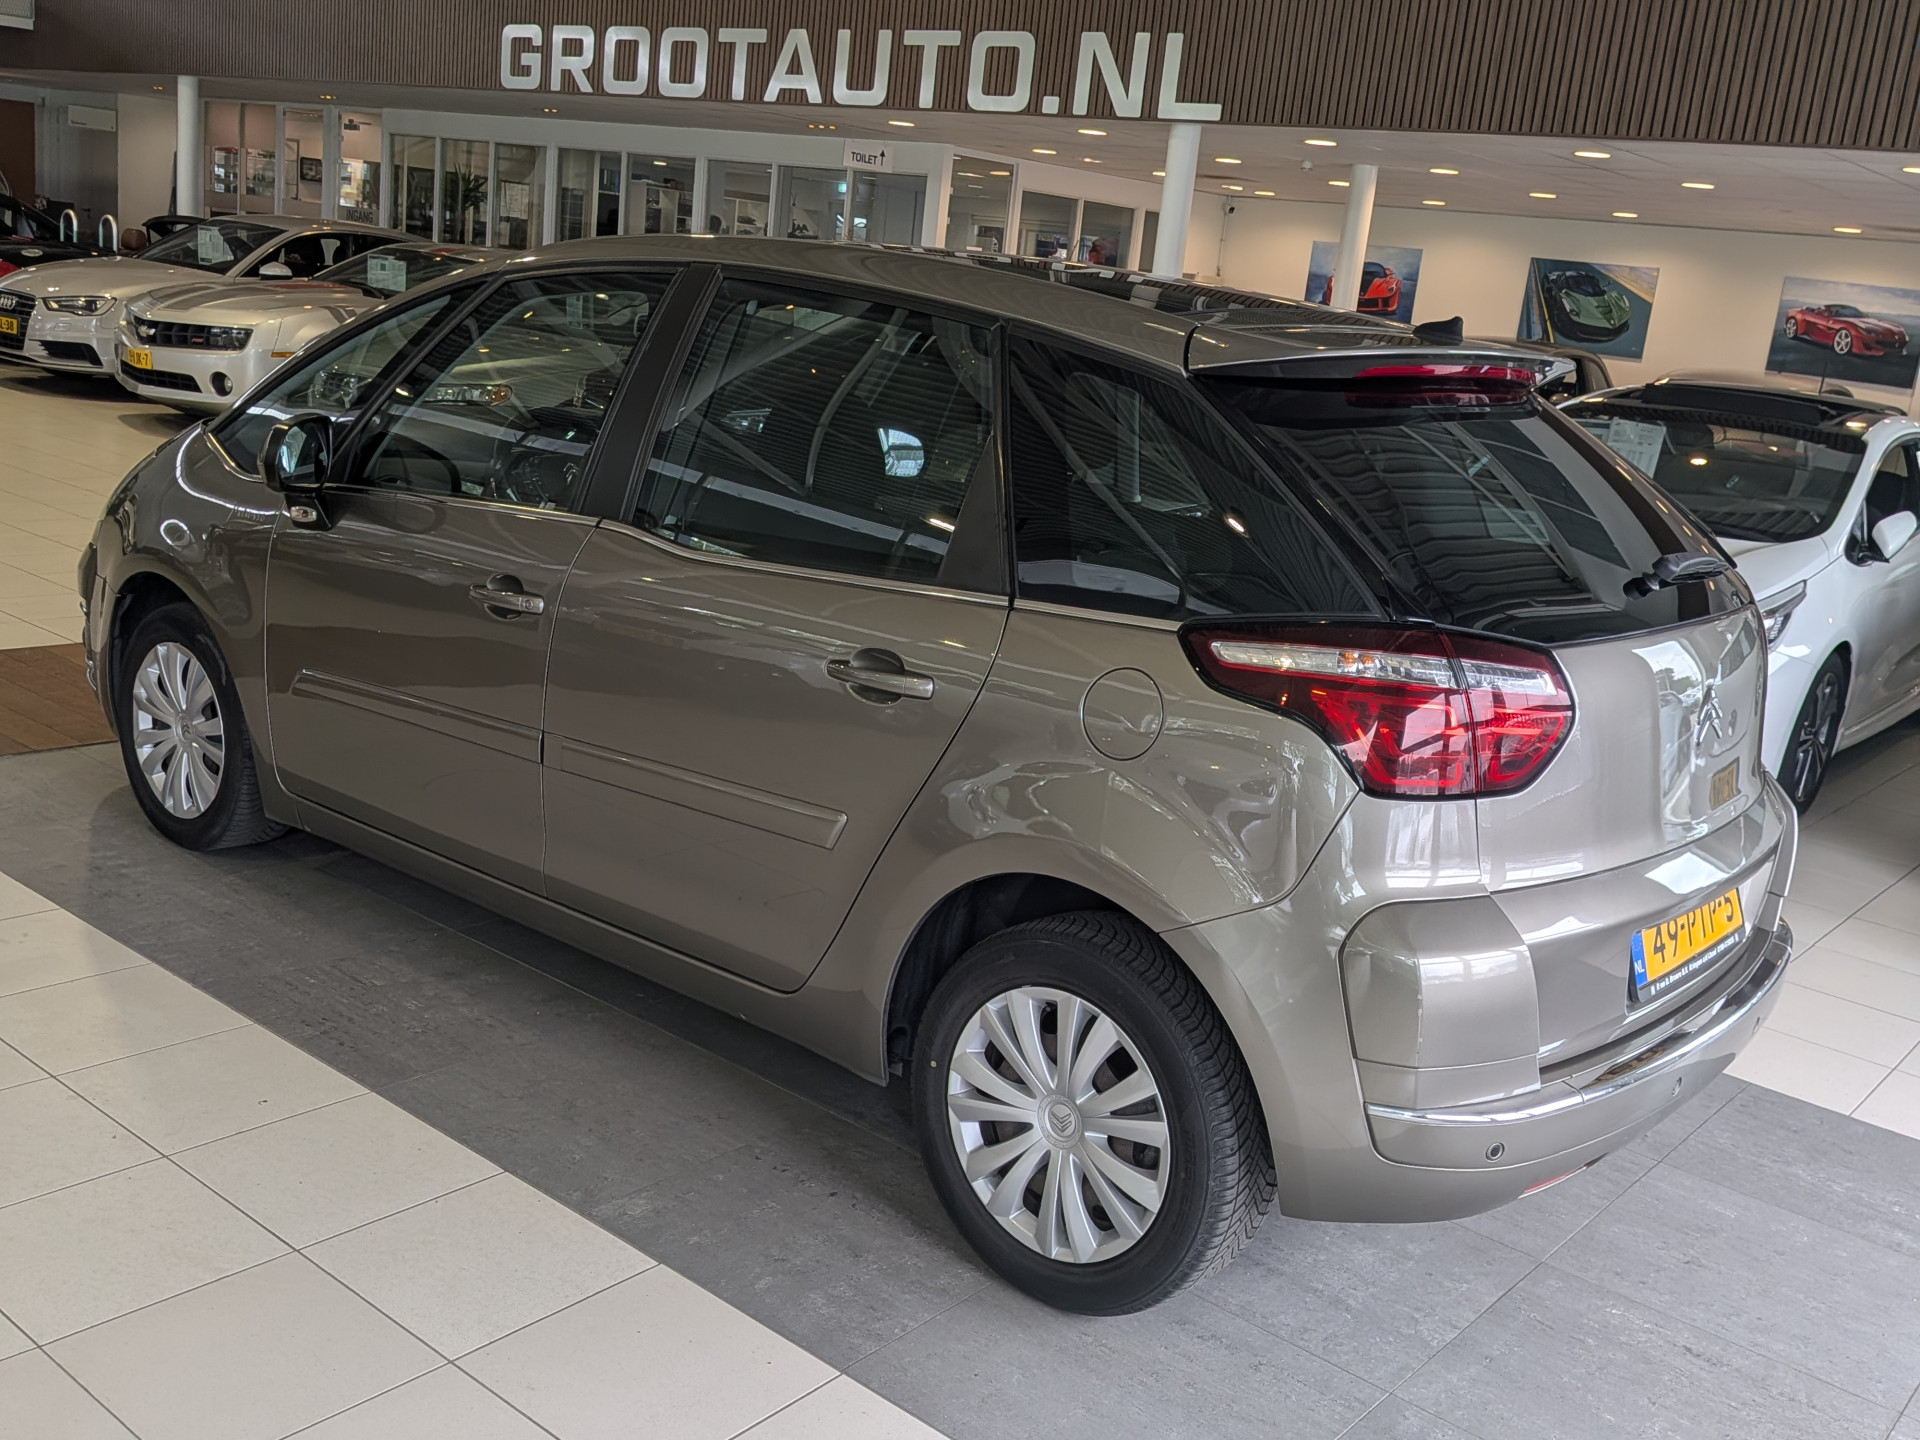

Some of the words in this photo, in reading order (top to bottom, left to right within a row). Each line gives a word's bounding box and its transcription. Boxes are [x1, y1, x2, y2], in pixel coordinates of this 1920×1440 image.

[500, 23, 1222, 121] GROOTAUTO.NL
[851, 151, 878, 165] TOILET
[346, 208, 374, 223] INGANG
[1634, 959, 1645, 975] NL
